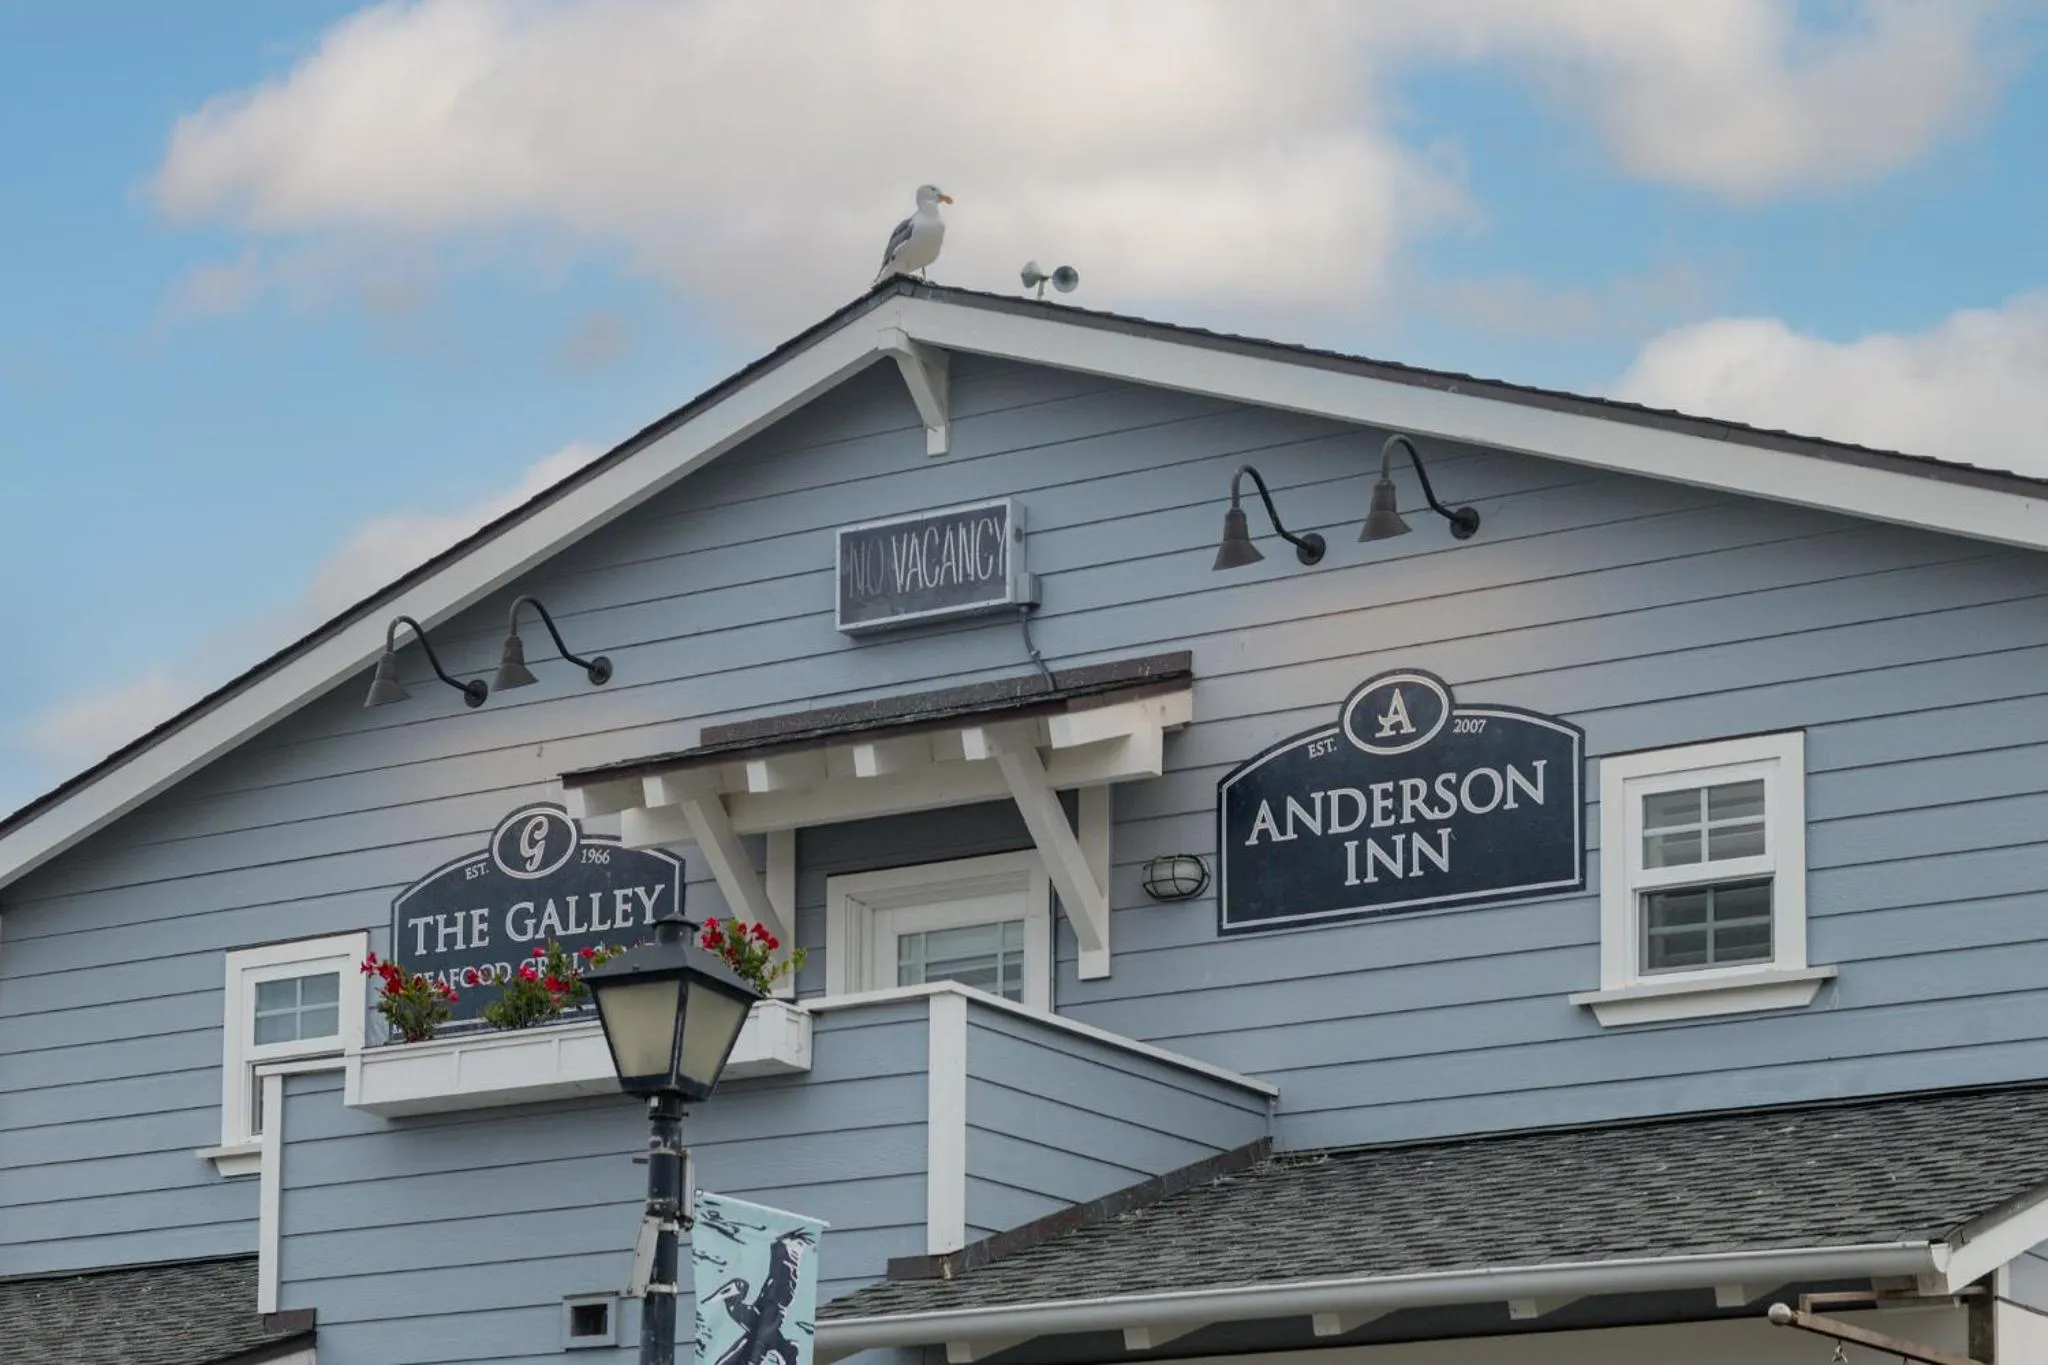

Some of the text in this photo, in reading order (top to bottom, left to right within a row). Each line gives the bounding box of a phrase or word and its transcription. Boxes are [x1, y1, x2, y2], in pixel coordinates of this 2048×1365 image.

[850, 517, 1007, 598] NO VACANCY
[1308, 719, 1487, 759] EST. 2007
[1375, 687, 1416, 738] A
[1245, 760, 1548, 846] ANDERSON
[465, 849, 610, 880] EST. 1966
[519, 815, 549, 872] G
[1344, 828, 1452, 886] INN
[407, 884, 666, 956] THE GALLEY
